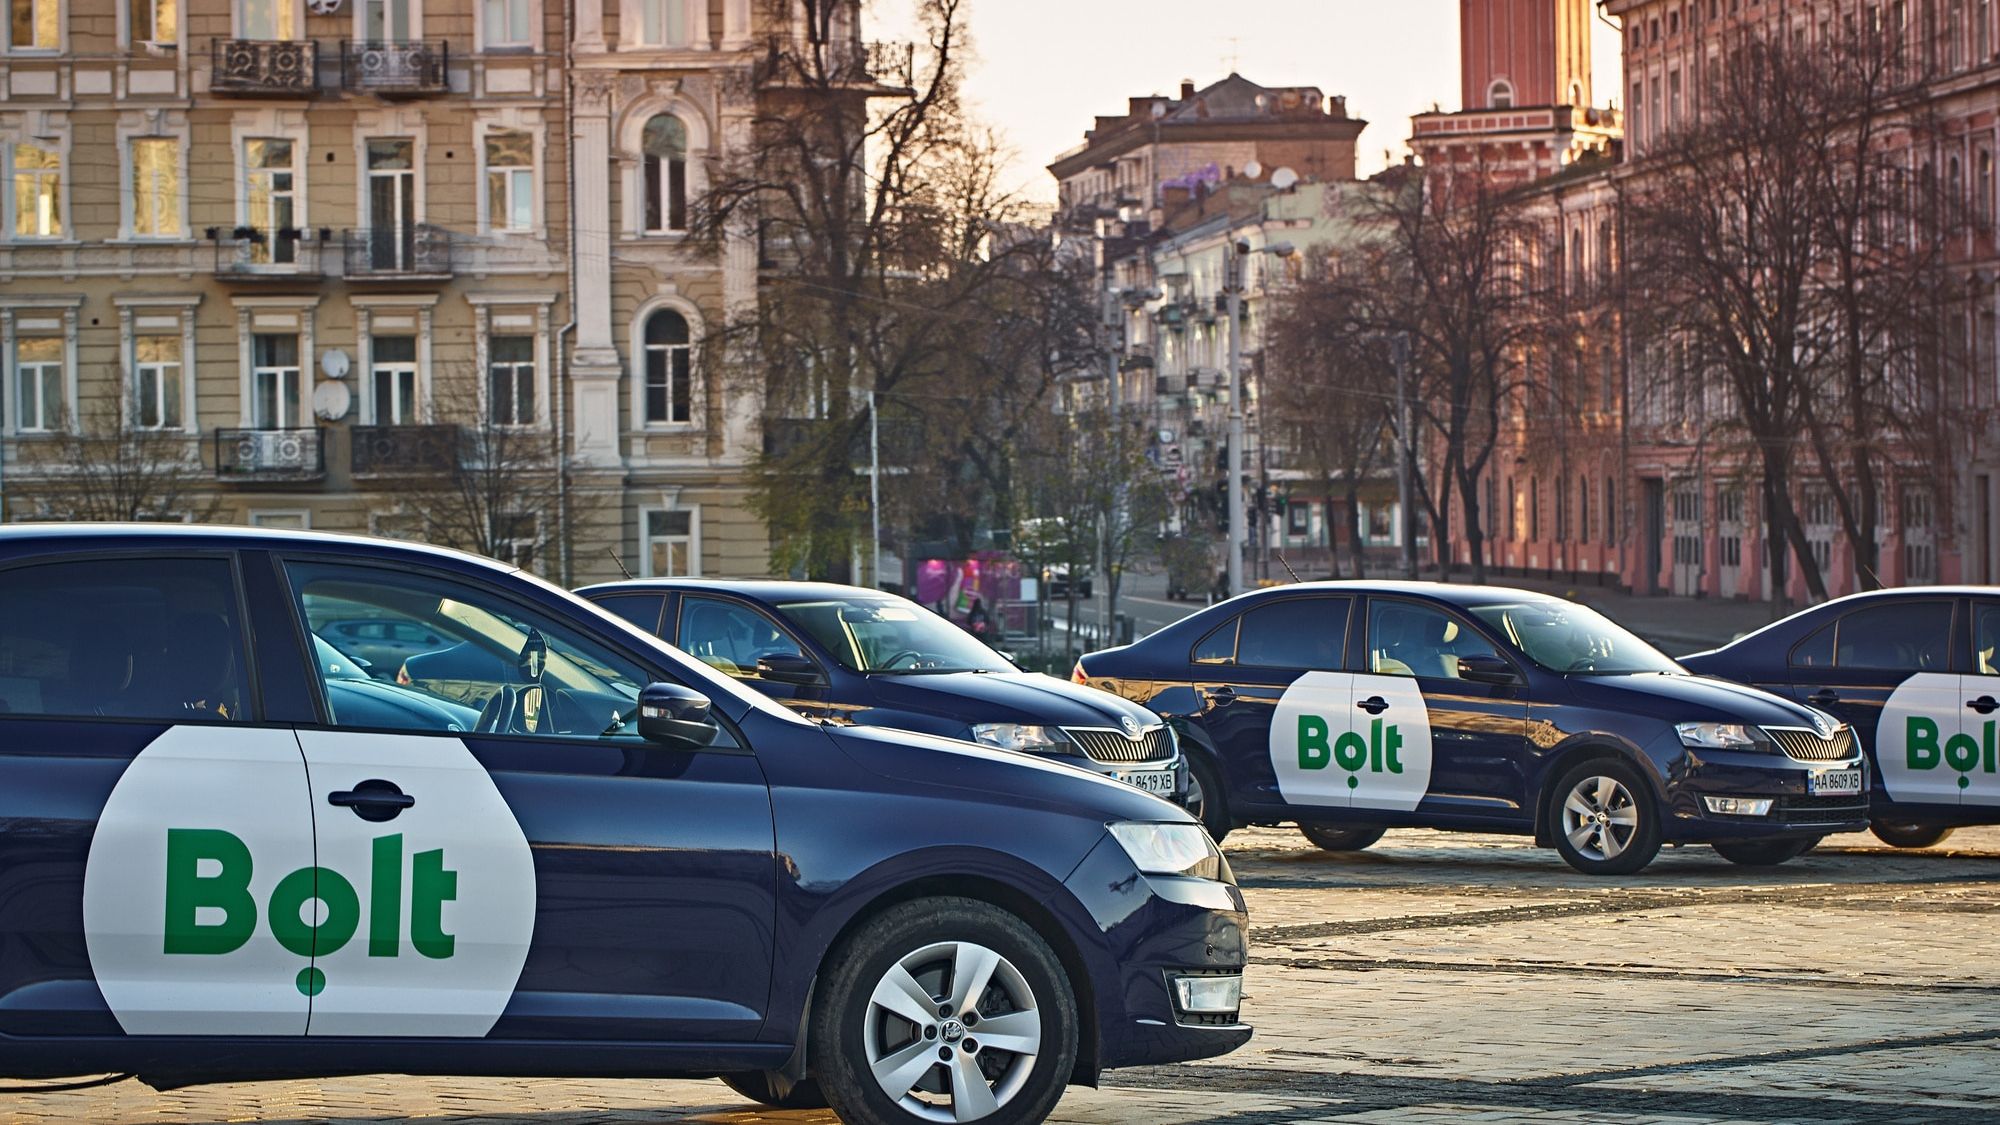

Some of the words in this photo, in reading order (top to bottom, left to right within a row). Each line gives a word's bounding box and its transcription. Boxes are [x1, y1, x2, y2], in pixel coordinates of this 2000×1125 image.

[1298, 715, 1403, 774] Bolt
[1906, 716, 2000, 774] Bol
[1160, 773, 1172, 790] XB
[1814, 775, 1828, 789] AA
[1829, 774, 1848, 789] 8609
[1849, 773, 1859, 788] XB
[163, 828, 458, 959] Bolt
